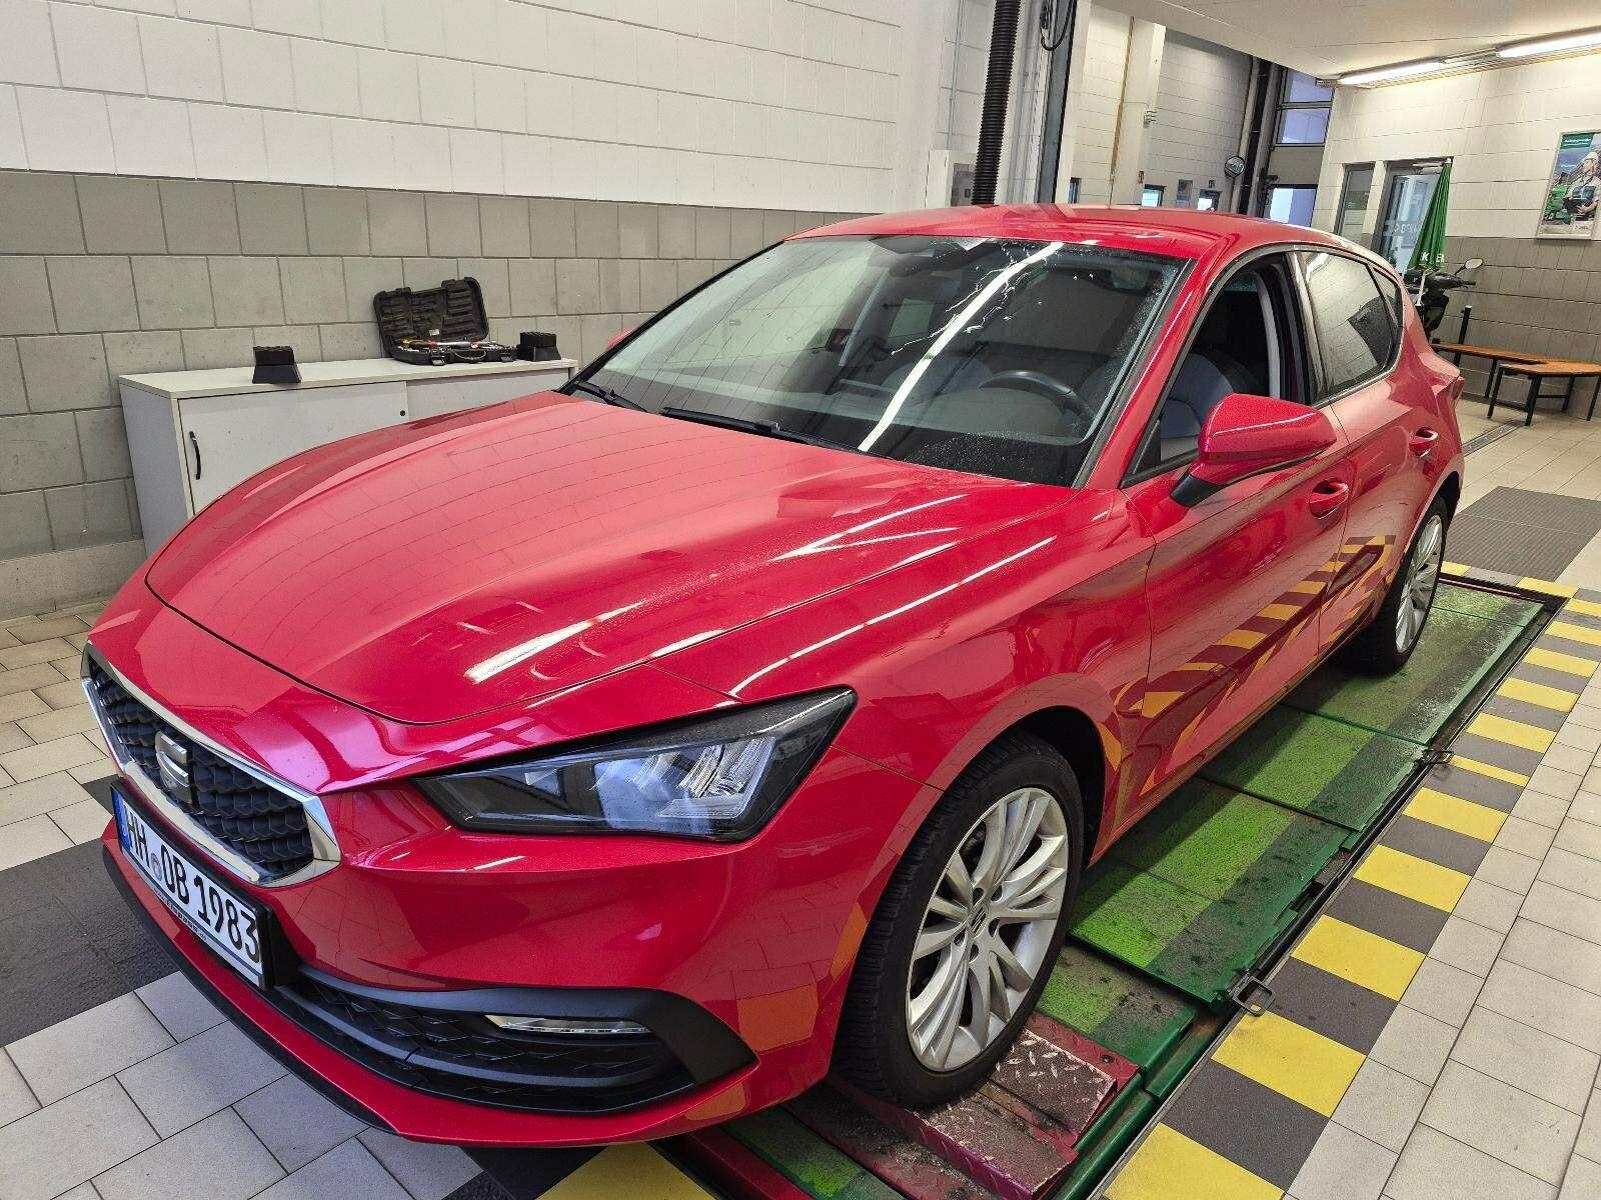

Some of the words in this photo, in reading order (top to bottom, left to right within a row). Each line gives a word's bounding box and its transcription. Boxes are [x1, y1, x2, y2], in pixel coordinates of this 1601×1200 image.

[123, 803, 150, 868] HH
[161, 844, 190, 904] OB
[194, 875, 260, 963] 1983
